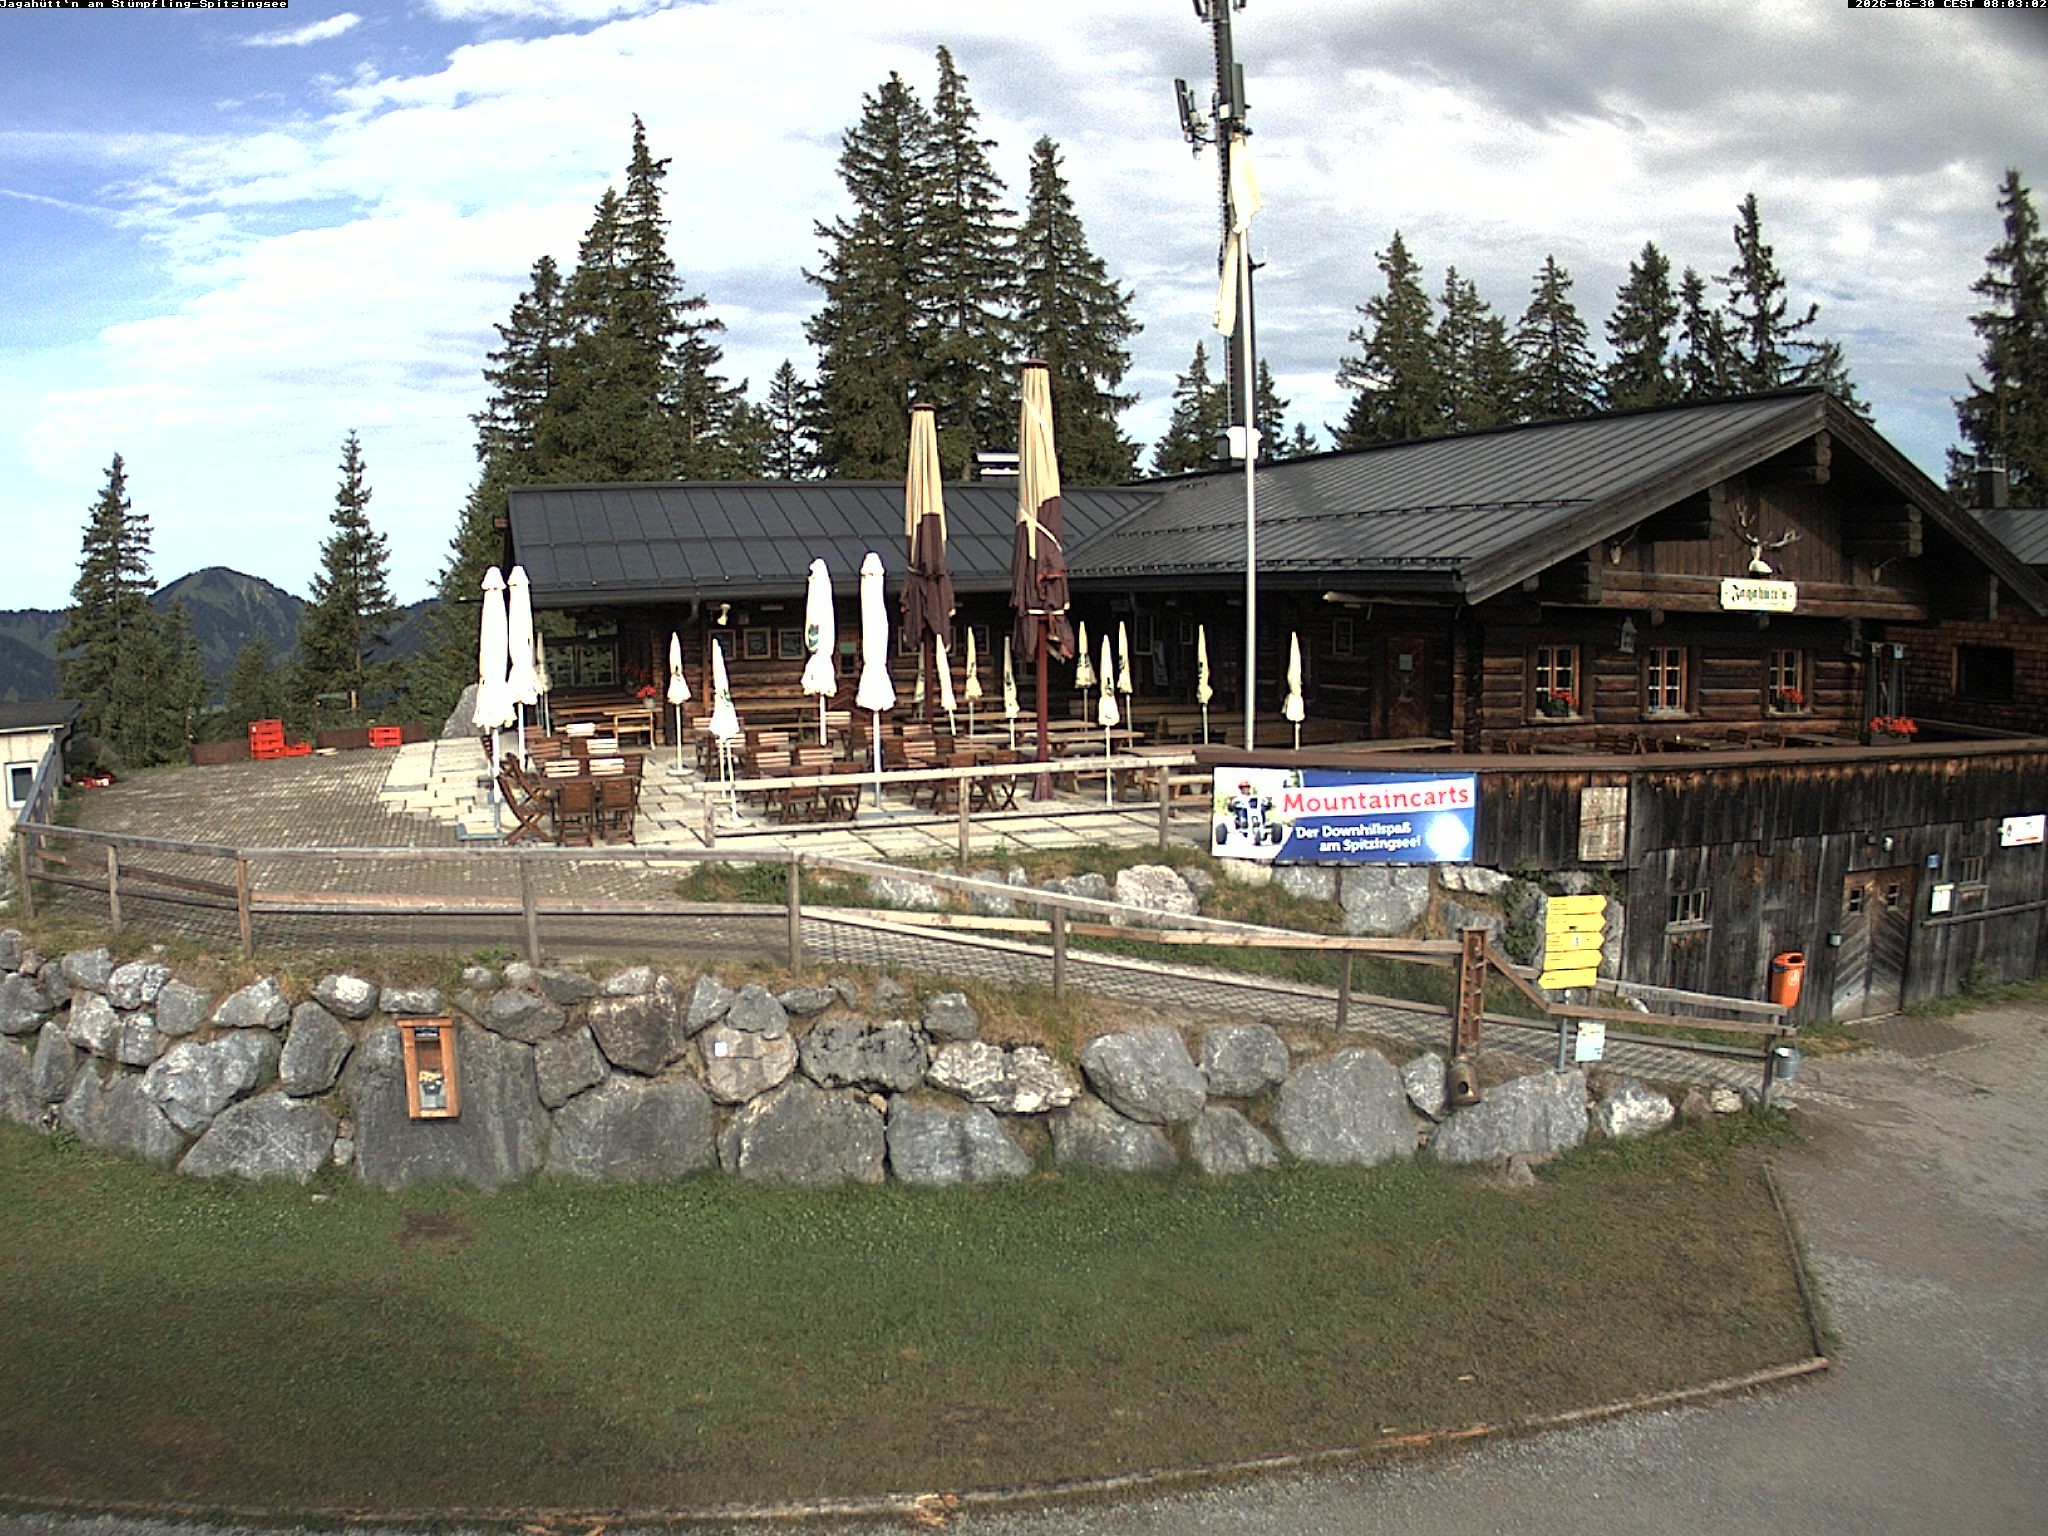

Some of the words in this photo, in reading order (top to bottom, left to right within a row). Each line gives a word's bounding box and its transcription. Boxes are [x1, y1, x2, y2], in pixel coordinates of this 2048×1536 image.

[1284, 787, 1468, 812] Mountaincarts
[1296, 826, 1320, 839] Der
[1322, 822, 1411, 837] Downhillspaß
[1319, 841, 1341, 852] am
